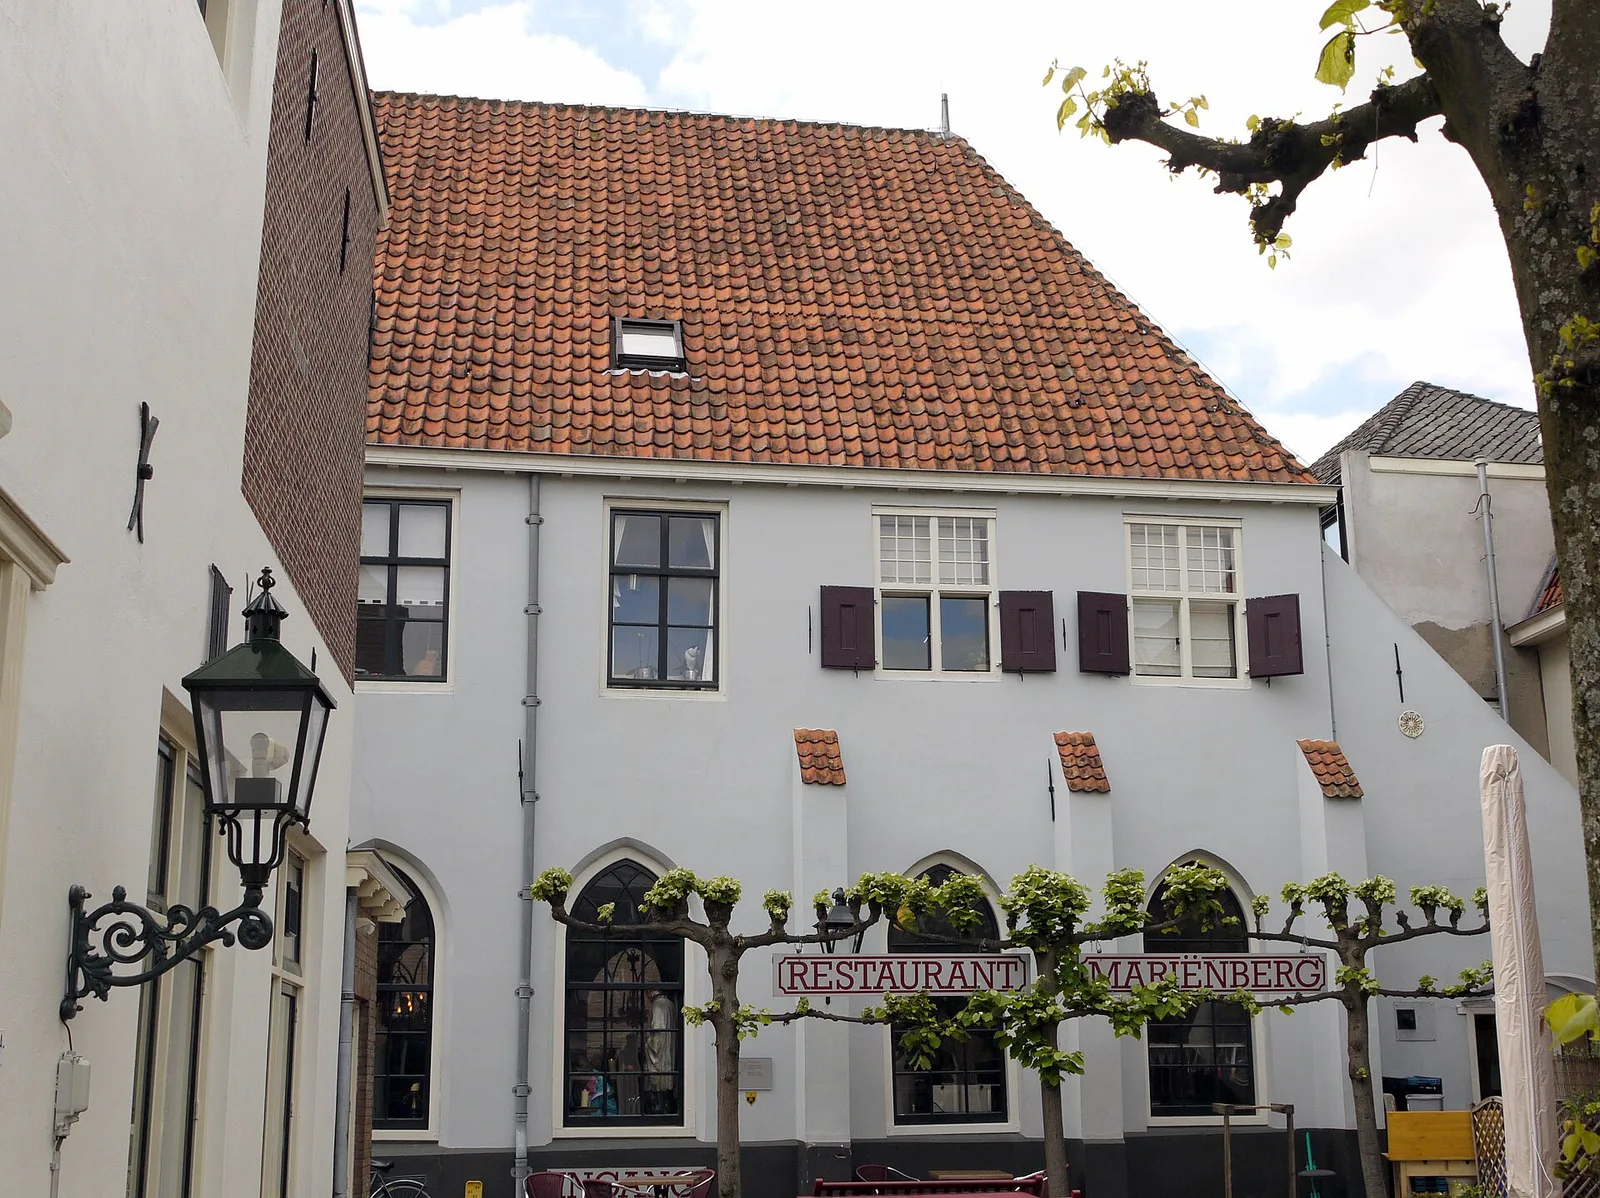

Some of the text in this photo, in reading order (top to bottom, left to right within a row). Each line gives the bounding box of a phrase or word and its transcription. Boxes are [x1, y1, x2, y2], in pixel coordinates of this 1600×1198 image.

[787, 960, 1018, 990] RESTAURANT
[1088, 954, 1321, 989] MARIËNBERG
[560, 1170, 694, 1198] NGAG
